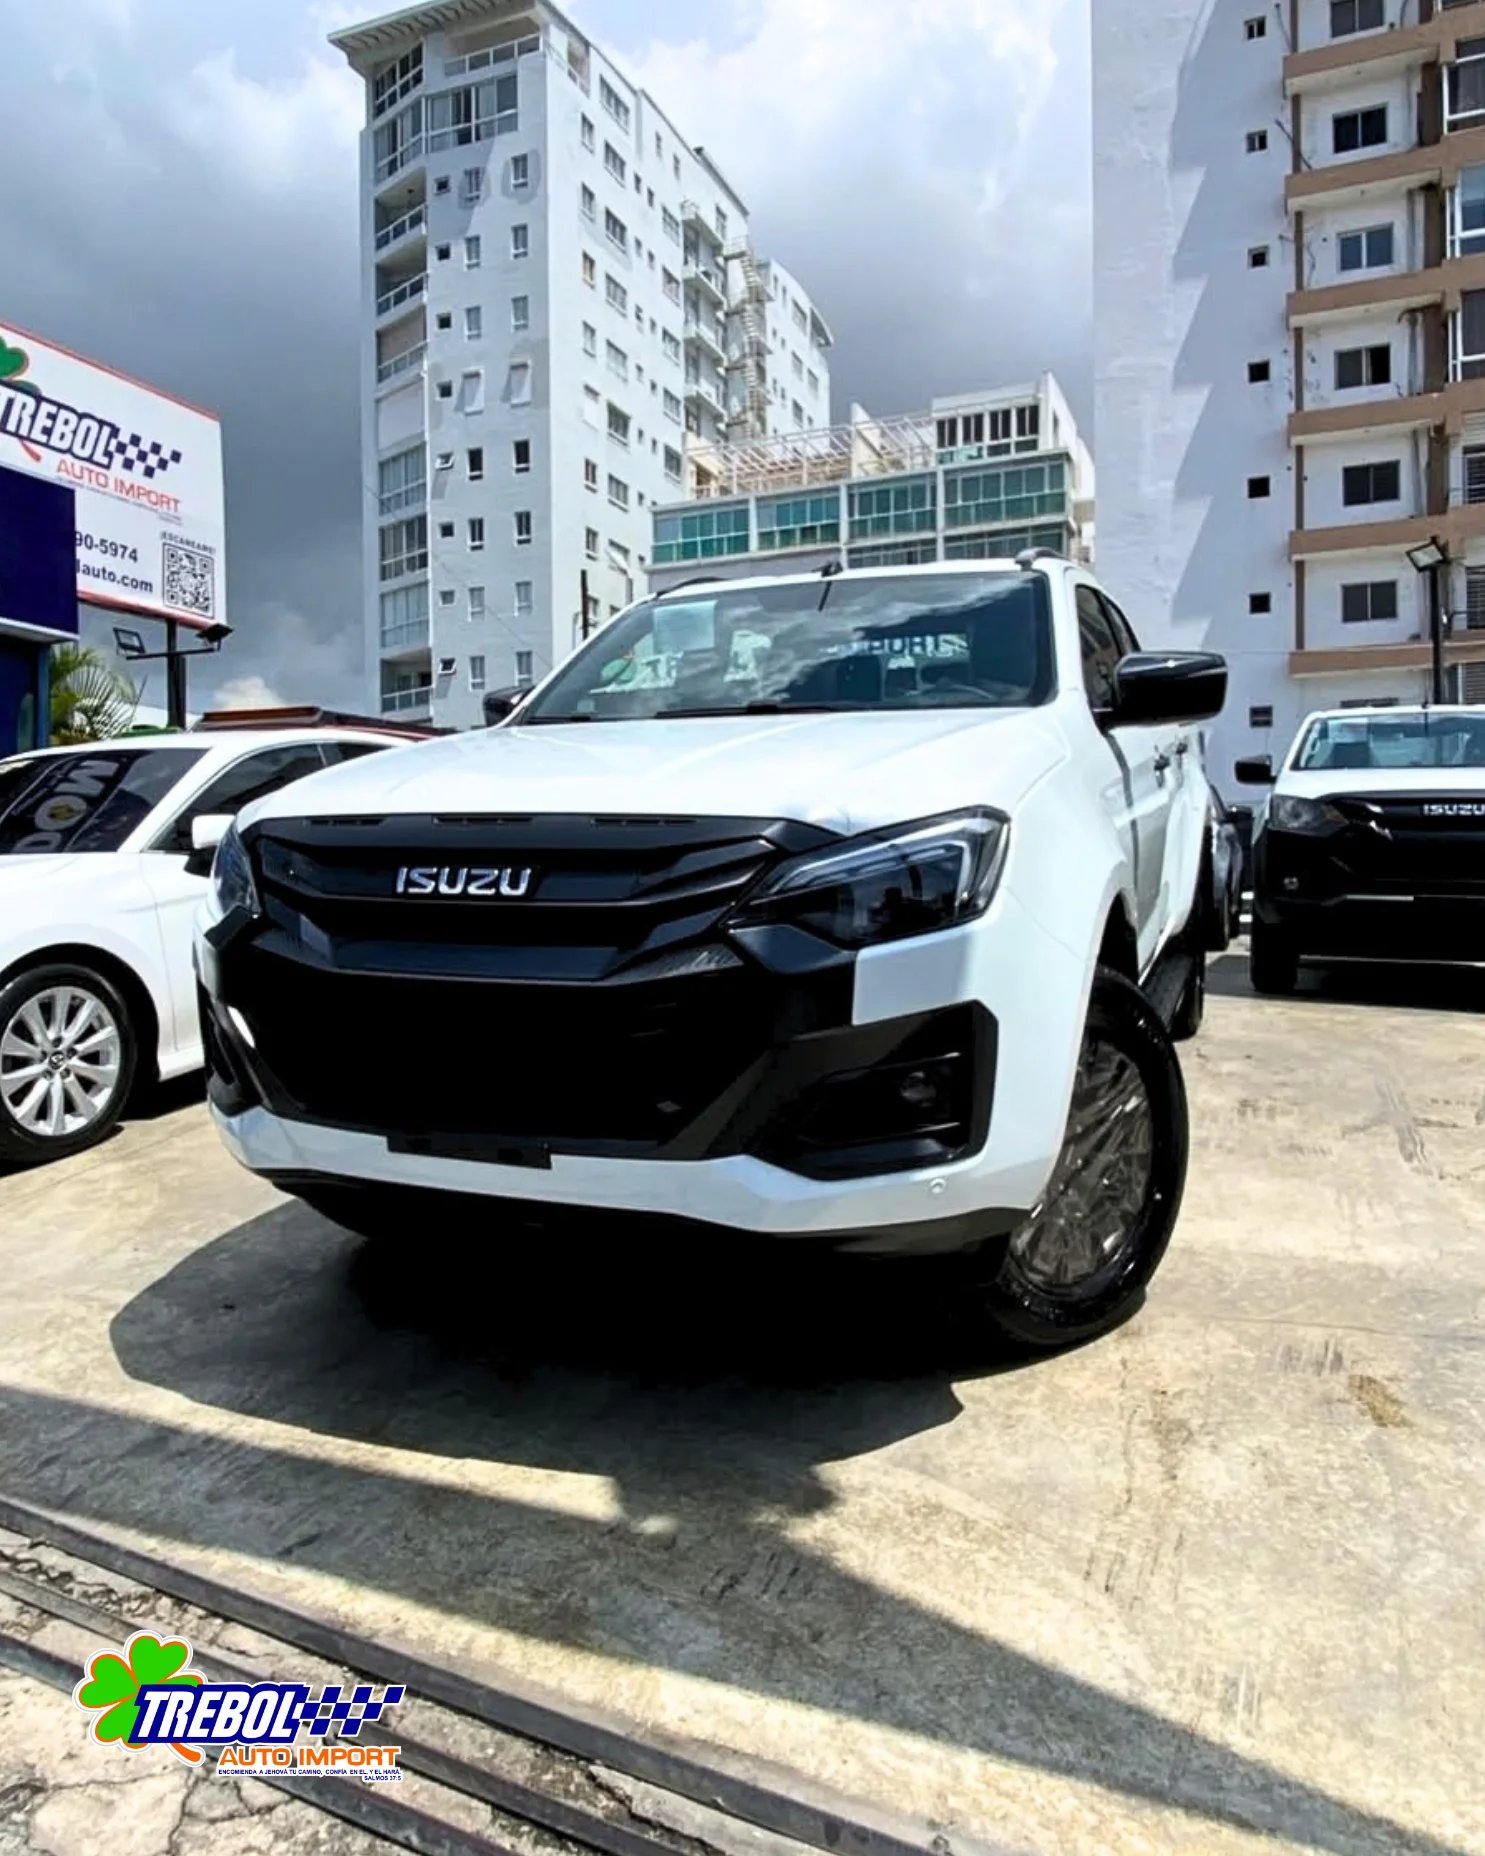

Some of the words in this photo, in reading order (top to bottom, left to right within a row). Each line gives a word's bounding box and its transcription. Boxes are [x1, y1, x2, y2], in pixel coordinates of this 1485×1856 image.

[56, 458, 109, 489] AUTO
[114, 477, 181, 512] IMPORT
[1423, 804, 1485, 816] ISUZU
[396, 866, 532, 896] ISUZU
